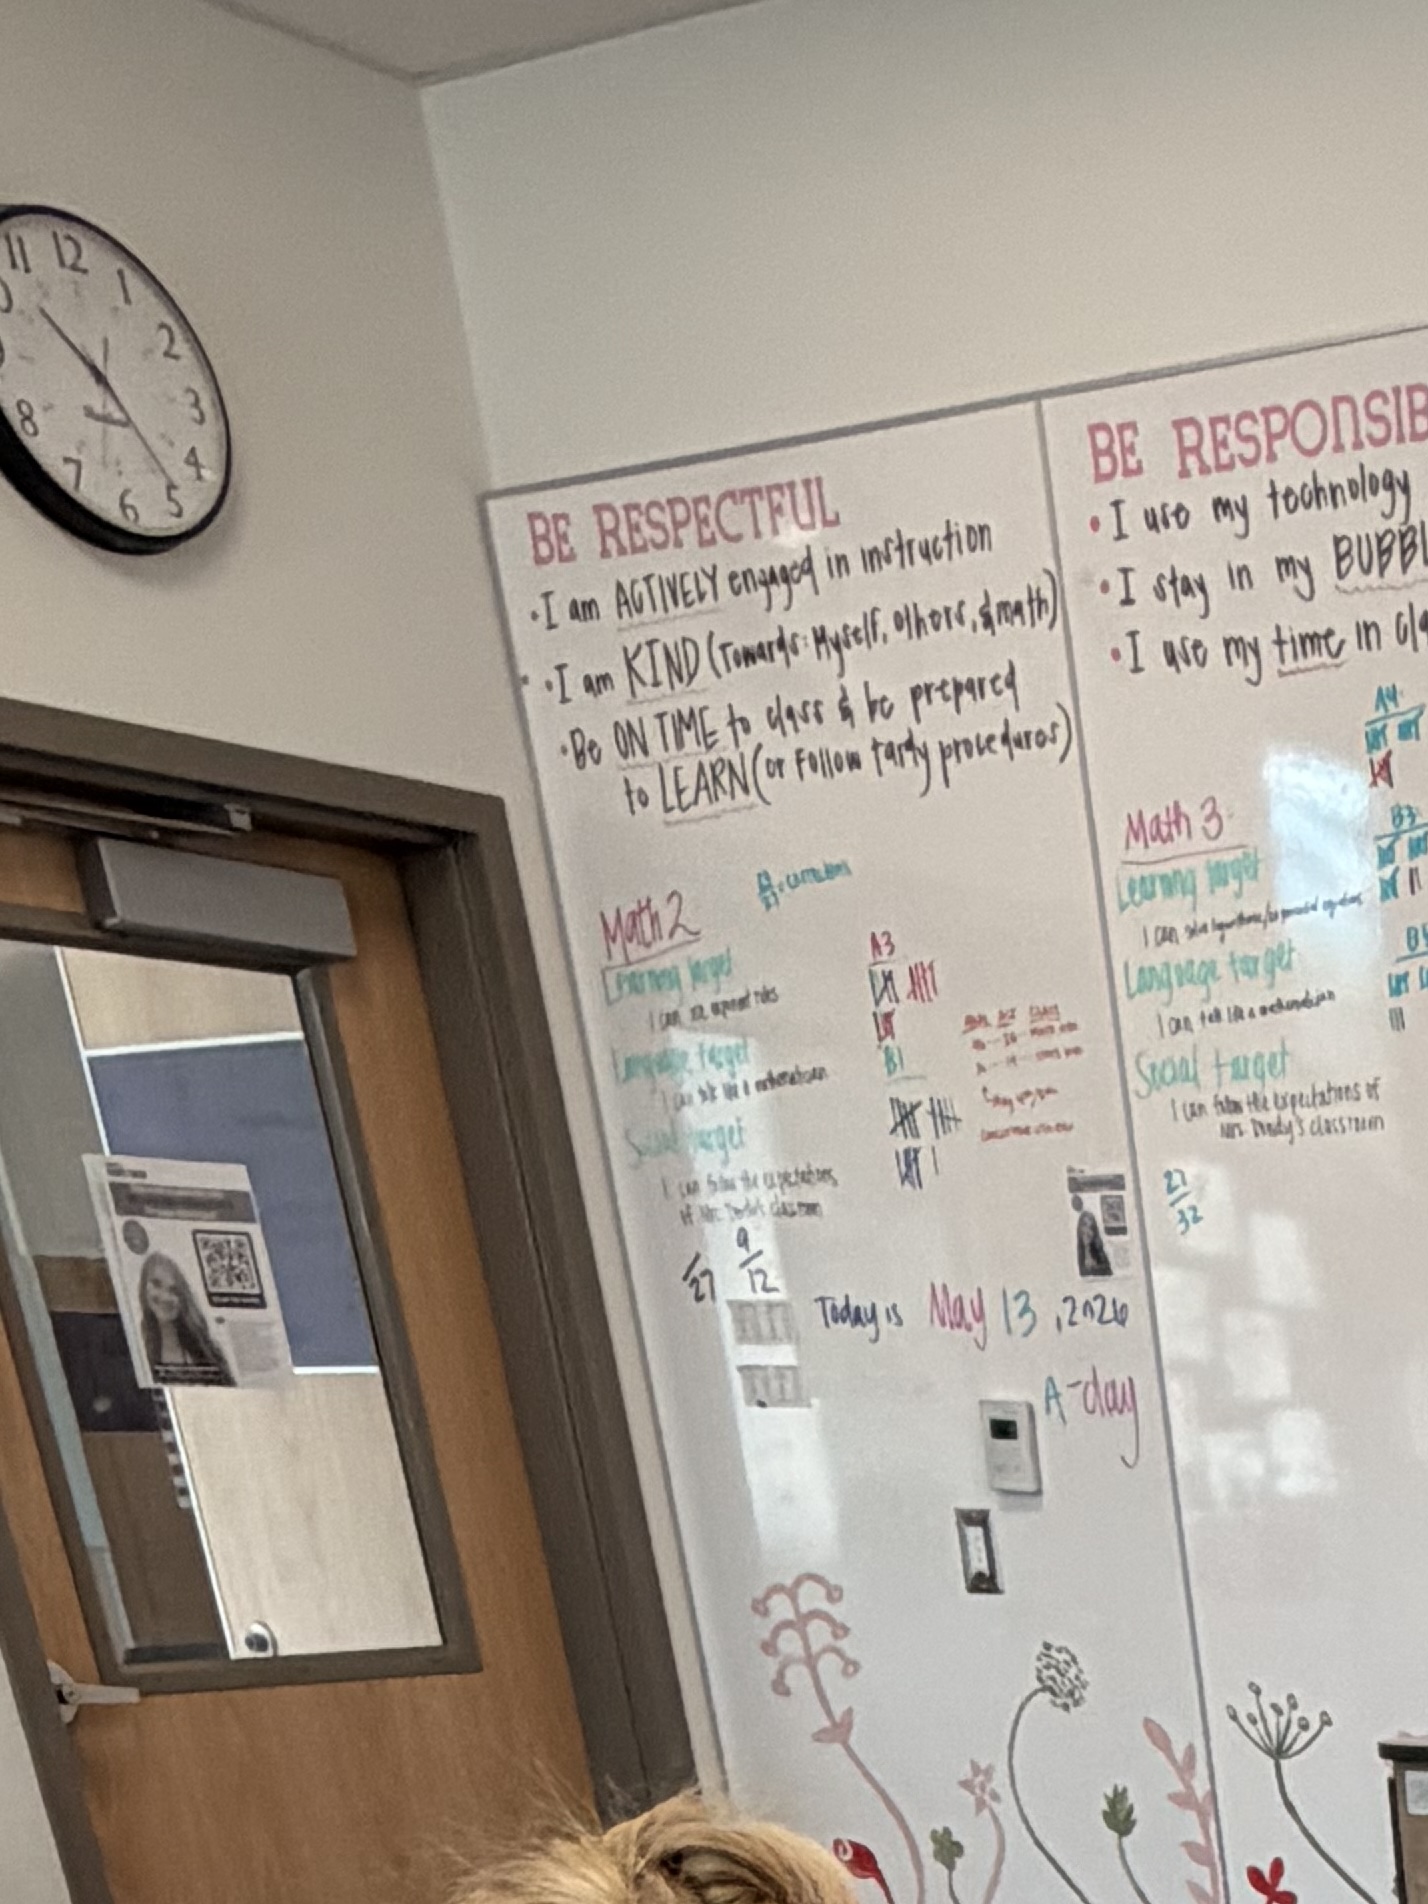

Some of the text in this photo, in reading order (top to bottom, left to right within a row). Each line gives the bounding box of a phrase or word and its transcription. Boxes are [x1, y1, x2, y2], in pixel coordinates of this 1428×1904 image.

[4, 233, 31, 274] 11
[53, 232, 88, 274] 12
[117, 268, 132, 305] 1
[157, 323, 181, 361] 2
[16, 399, 39, 437] 8
[186, 387, 205, 425] 3
[64, 457, 82, 491] 7
[185, 446, 204, 481] 4
[1087, 421, 1143, 483] BE
[119, 489, 139, 524] 6
[166, 483, 183, 518] 5
[528, 477, 840, 565] BE RESPECTFUL
[1112, 500, 1130, 540] I
[1144, 505, 1191, 530] use
[1213, 497, 1250, 538] my
[1269, 464, 1411, 523] technology
[540, 519, 991, 629] I am ACTIVELY engaged in instruction
[1119, 567, 1135, 606] I
[1152, 573, 1210, 619] stay
[1227, 563, 1254, 589] in
[1275, 555, 1315, 600] my
[553, 665, 568, 703] I
[584, 671, 614, 695] am
[623, 636, 702, 694] KIND
[1127, 635, 1145, 674] I
[1163, 640, 1209, 669] use
[1224, 634, 1261, 686] my
[1274, 622, 1346, 661] time
[1355, 621, 1381, 649] in
[569, 726, 601, 769] Be
[614, 710, 647, 761] ON
[658, 707, 718, 751] TIME
[726, 712, 752, 743] to
[767, 695, 825, 740] class
[864, 681, 894, 723] be
[910, 661, 1016, 718] prepared
[624, 773, 648, 815] to
[870, 730, 931, 797] tardy
[1125, 795, 1223, 850] Math 3
[600, 889, 701, 965] Math 2
[1124, 959, 1221, 1006] Language
[1134, 1043, 1199, 1099] Social
[816, 1295, 879, 1344] Today
[886, 1306, 902, 1328] is
[930, 1281, 987, 1351] May
[1003, 1288, 1037, 1338] 13
